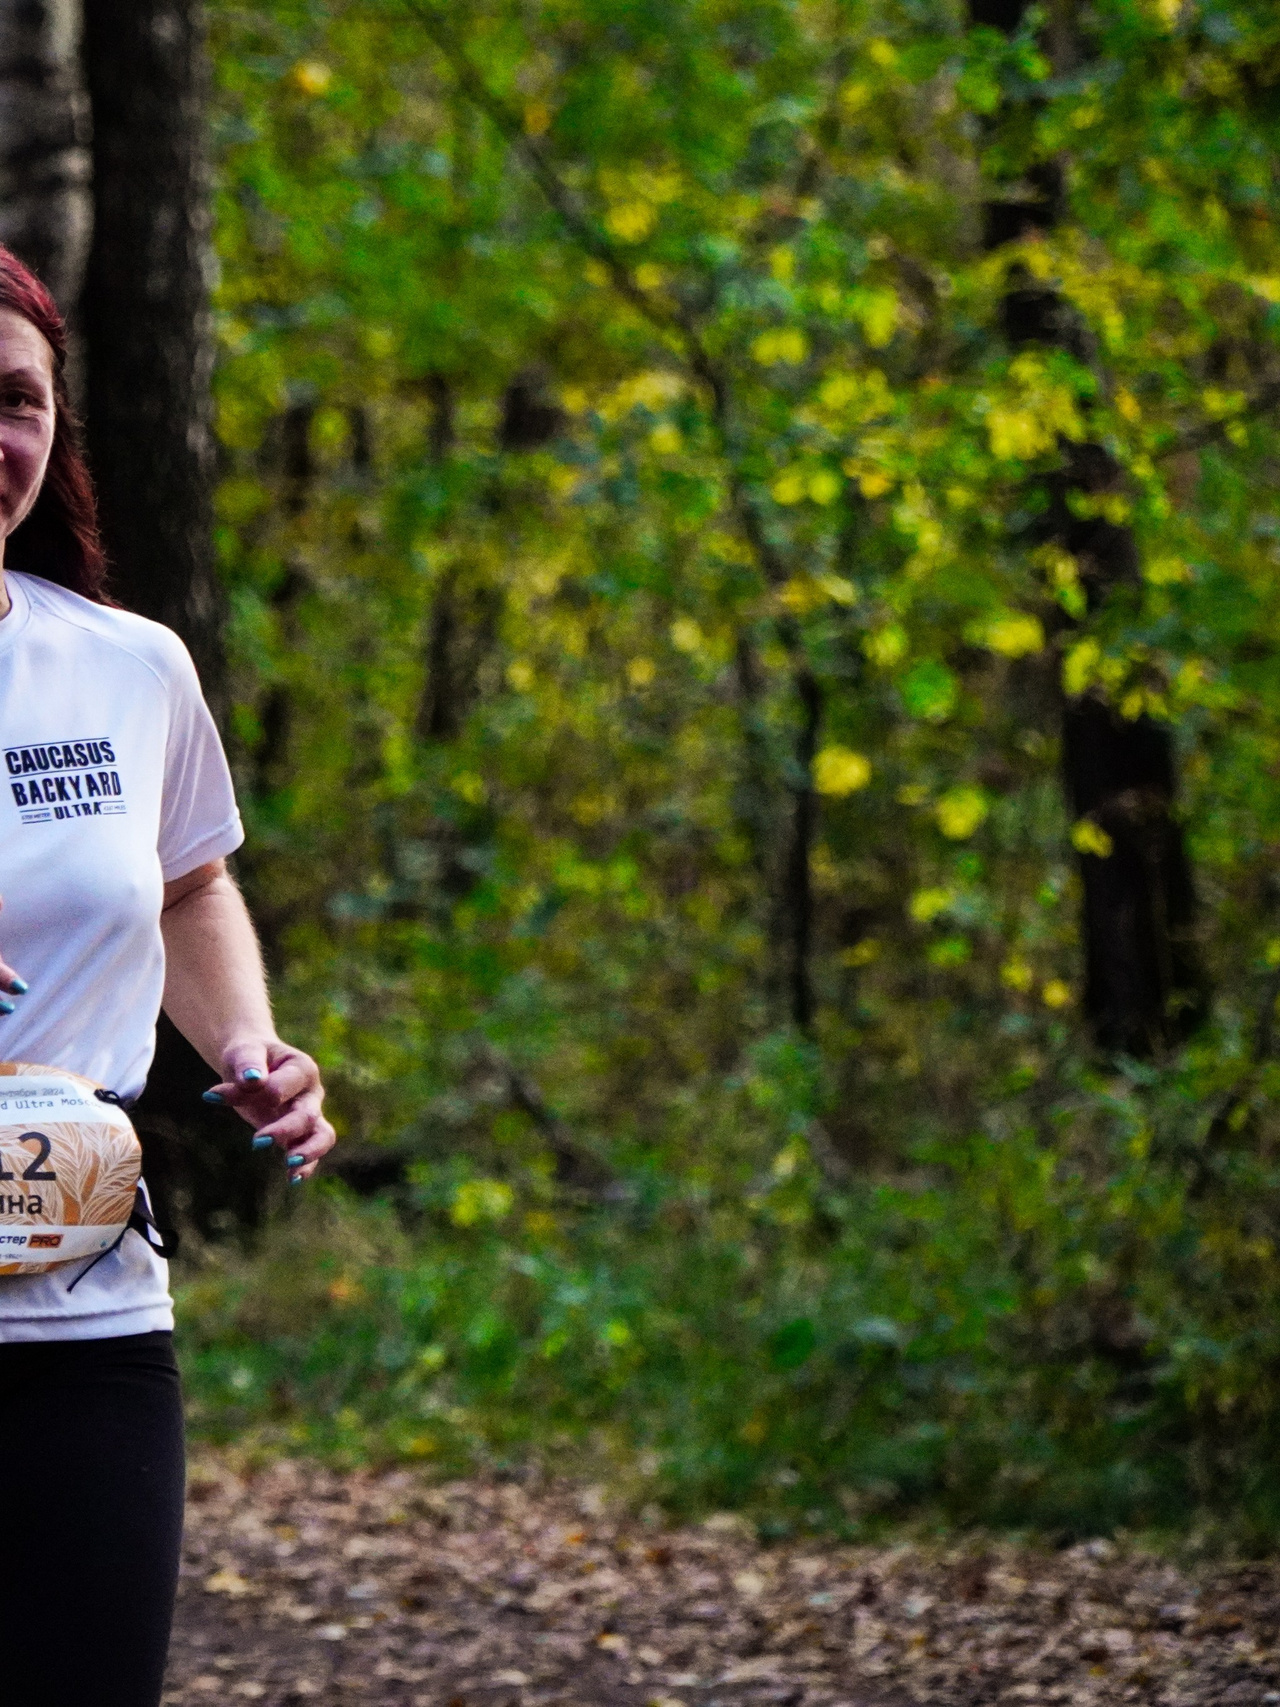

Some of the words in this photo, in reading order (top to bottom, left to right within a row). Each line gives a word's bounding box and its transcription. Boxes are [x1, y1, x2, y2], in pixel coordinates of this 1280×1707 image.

[5, 741, 116, 775] CAUCASUS
[11, 771, 122, 807] BACKYARD
[54, 802, 102, 820] ULTRA
[16, 1099, 54, 1110] Ultra
[29, 1235, 62, 1247] PRO
